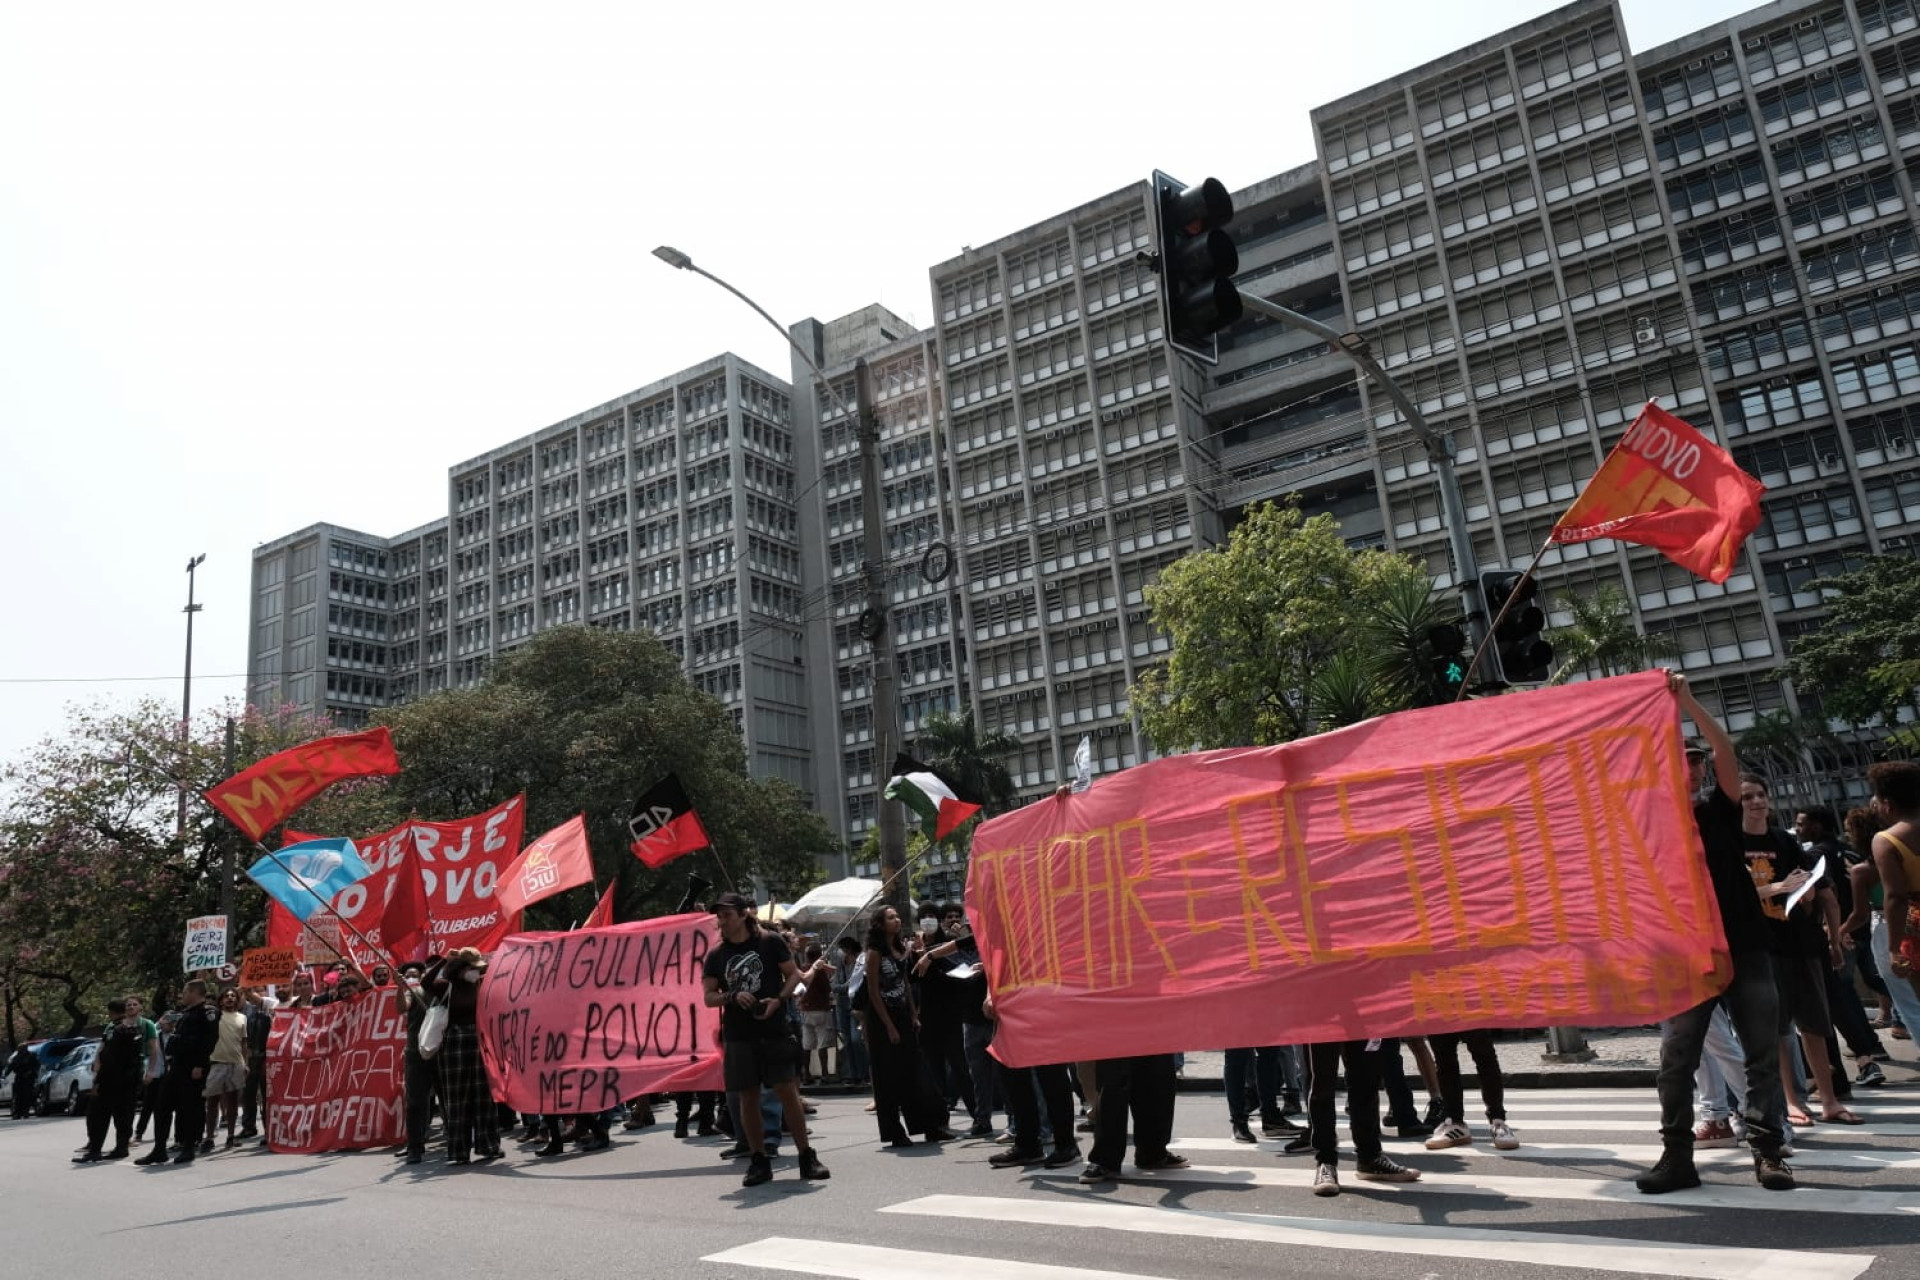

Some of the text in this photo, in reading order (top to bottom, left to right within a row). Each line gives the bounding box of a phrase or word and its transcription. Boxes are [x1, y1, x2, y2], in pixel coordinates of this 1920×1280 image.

[1622, 416, 1700, 479] NOVO
[484, 798, 521, 853] É
[1179, 849, 1223, 934] E
[187, 954, 225, 970] FOME
[485, 928, 709, 1009] FORA GULNAR
[1410, 958, 1578, 1023] NOVO
[531, 1025, 541, 1062] É
[544, 1032, 568, 1063] DO
[580, 1001, 699, 1063] POVO!
[284, 1045, 396, 1101] CONTRA
[539, 1066, 621, 1113] MEPR
[337, 1095, 408, 1143] FOM
